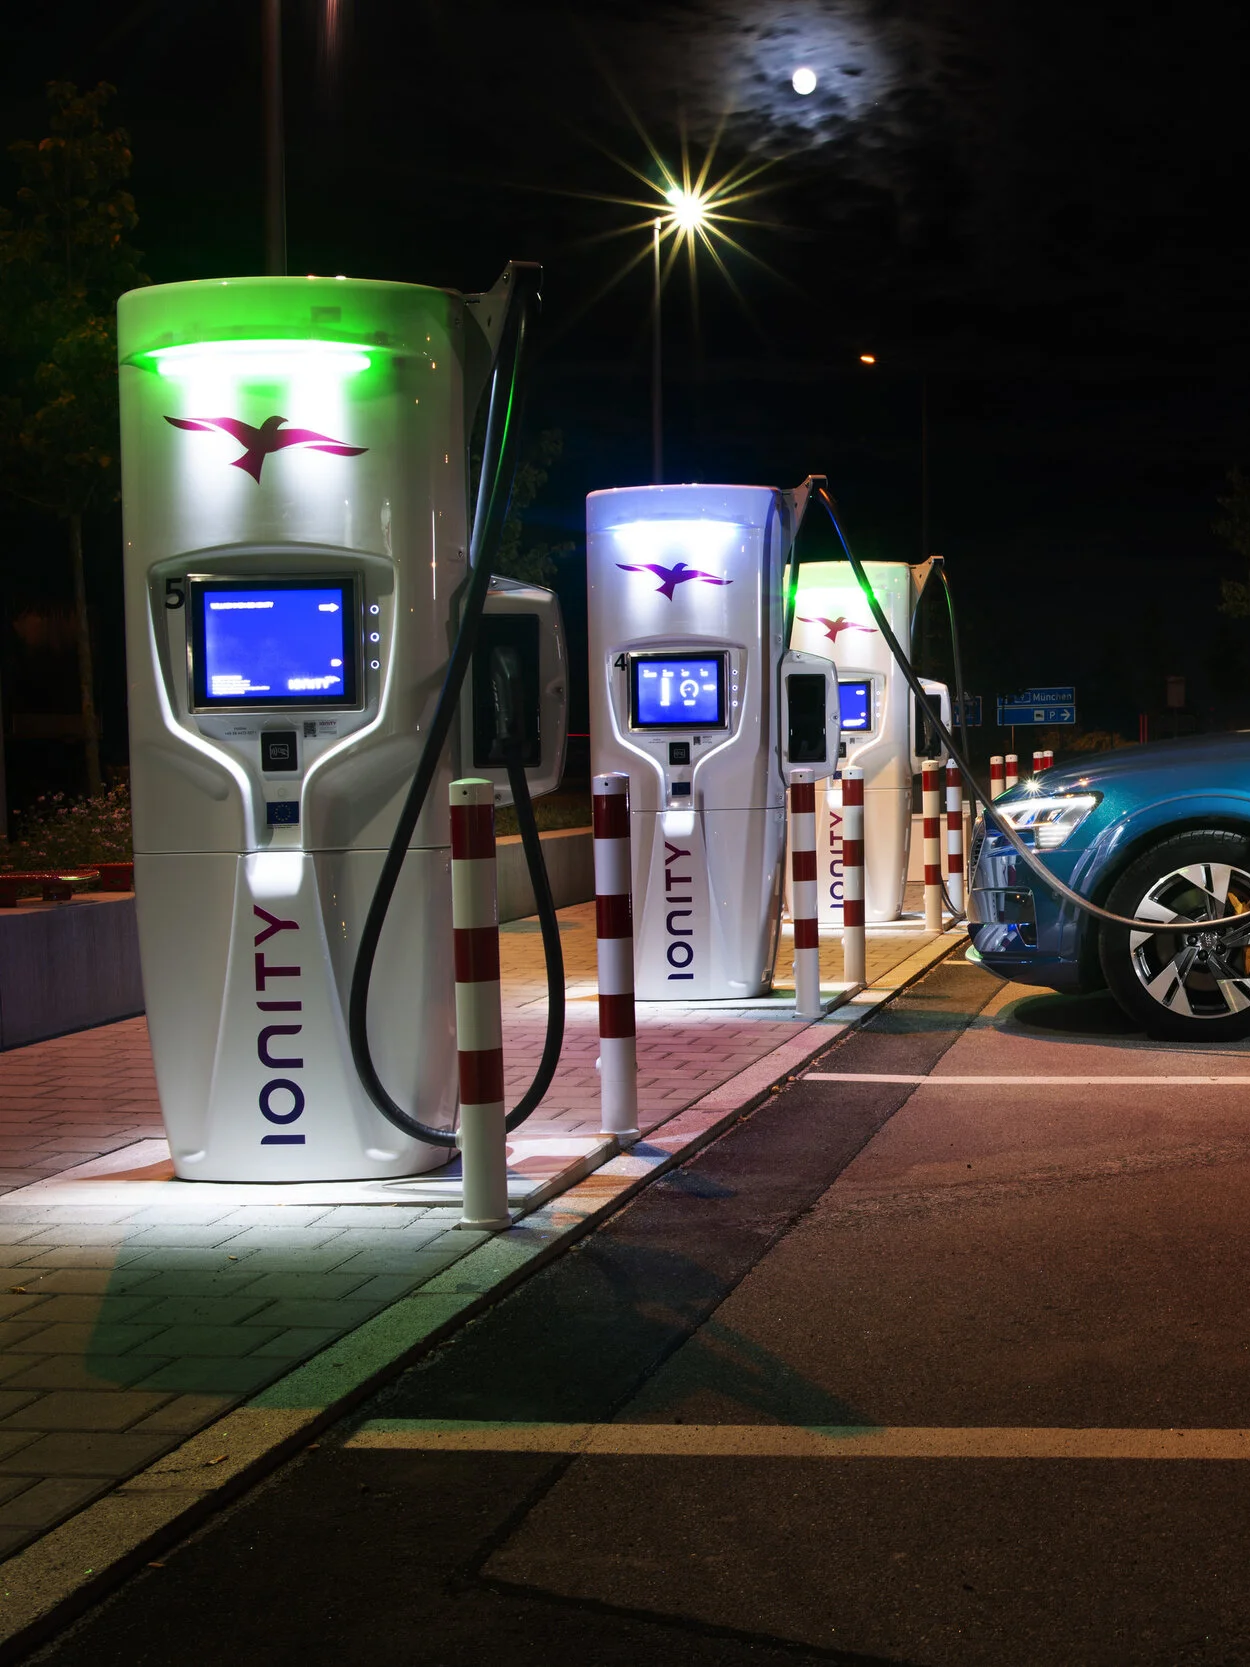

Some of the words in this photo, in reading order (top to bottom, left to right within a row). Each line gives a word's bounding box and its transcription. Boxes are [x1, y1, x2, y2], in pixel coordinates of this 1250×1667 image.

[165, 578, 185, 609] 5
[614, 652, 628, 671] 4
[1033, 692, 1072, 701] München
[829, 811, 844, 908] IONITY
[665, 841, 694, 980] IONITY
[253, 904, 306, 1145] IONITY
